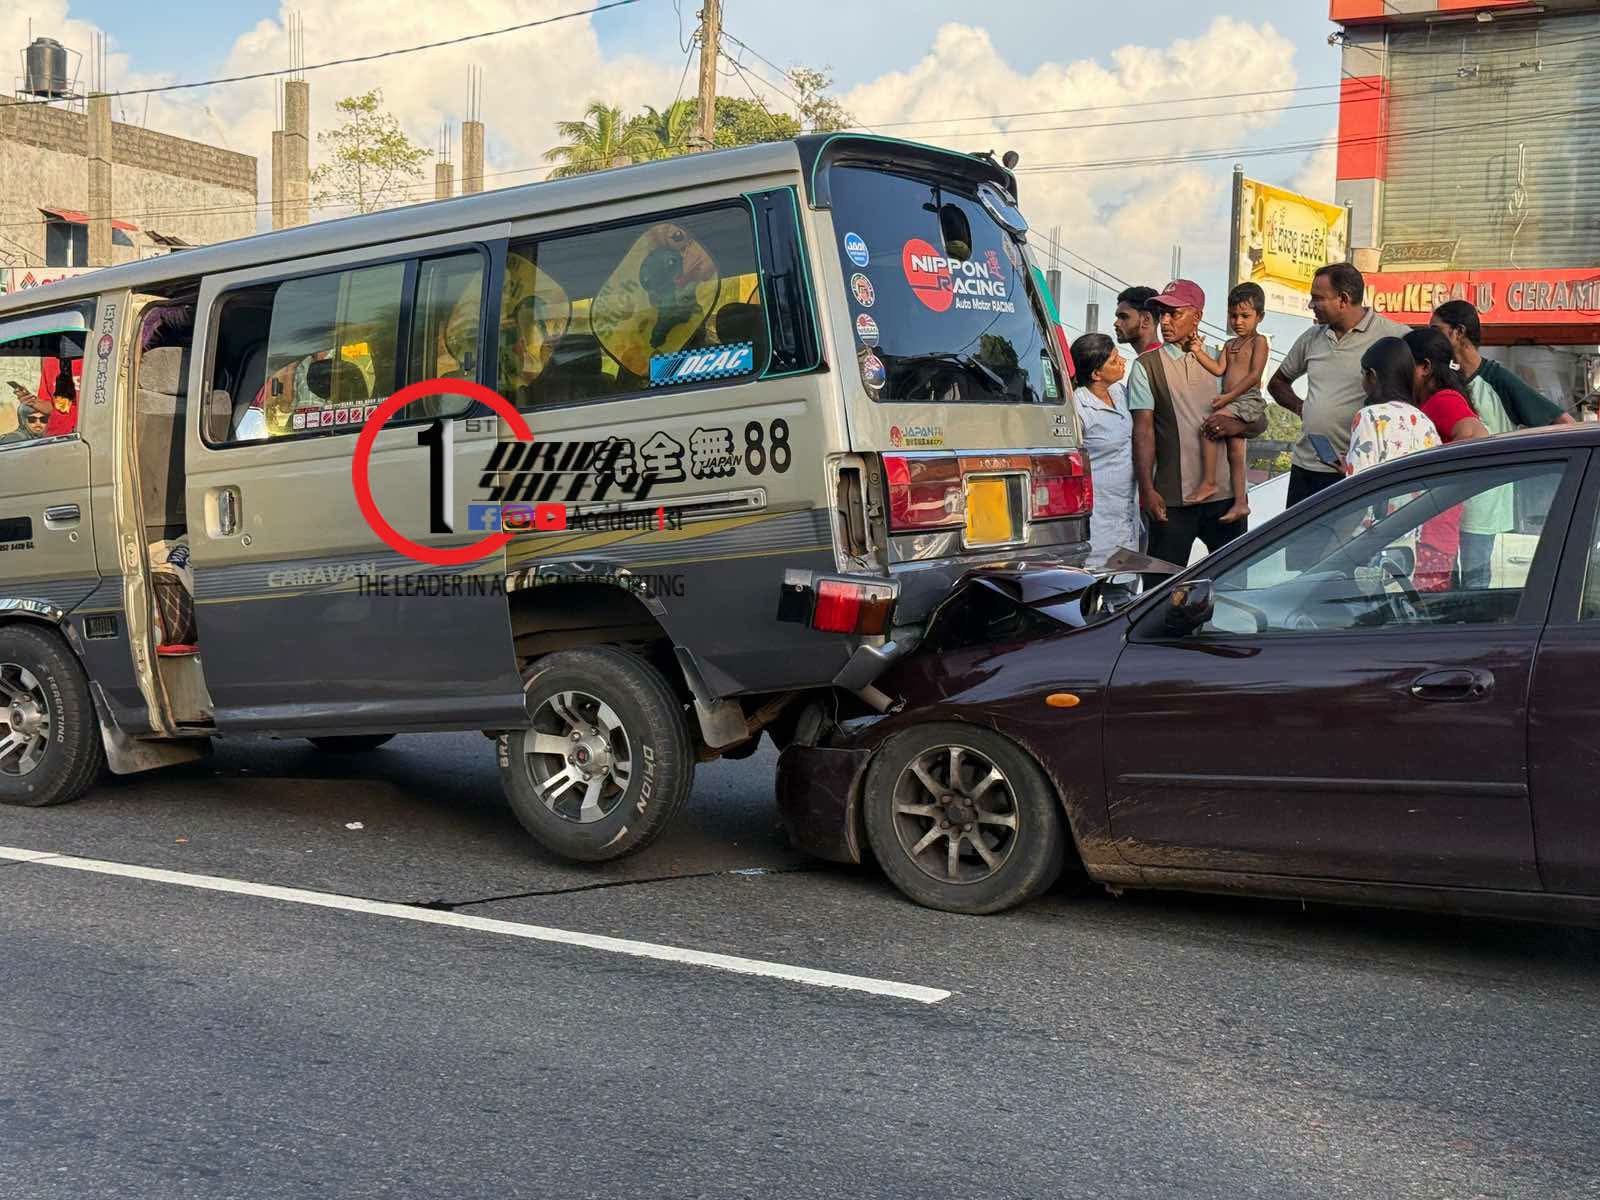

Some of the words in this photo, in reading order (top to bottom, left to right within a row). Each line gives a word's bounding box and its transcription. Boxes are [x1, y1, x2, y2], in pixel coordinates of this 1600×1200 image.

[910, 254, 990, 279] NIPPON
[955, 298, 972, 310] Auto
[972, 298, 991, 311] Motor
[992, 300, 1015, 313] RACING
[1363, 284, 1402, 313] New
[1402, 281, 1493, 314] KEGAU
[677, 349, 749, 377] DCAC
[744, 418, 792, 476] 88
[703, 455, 743, 469] JAPAN
